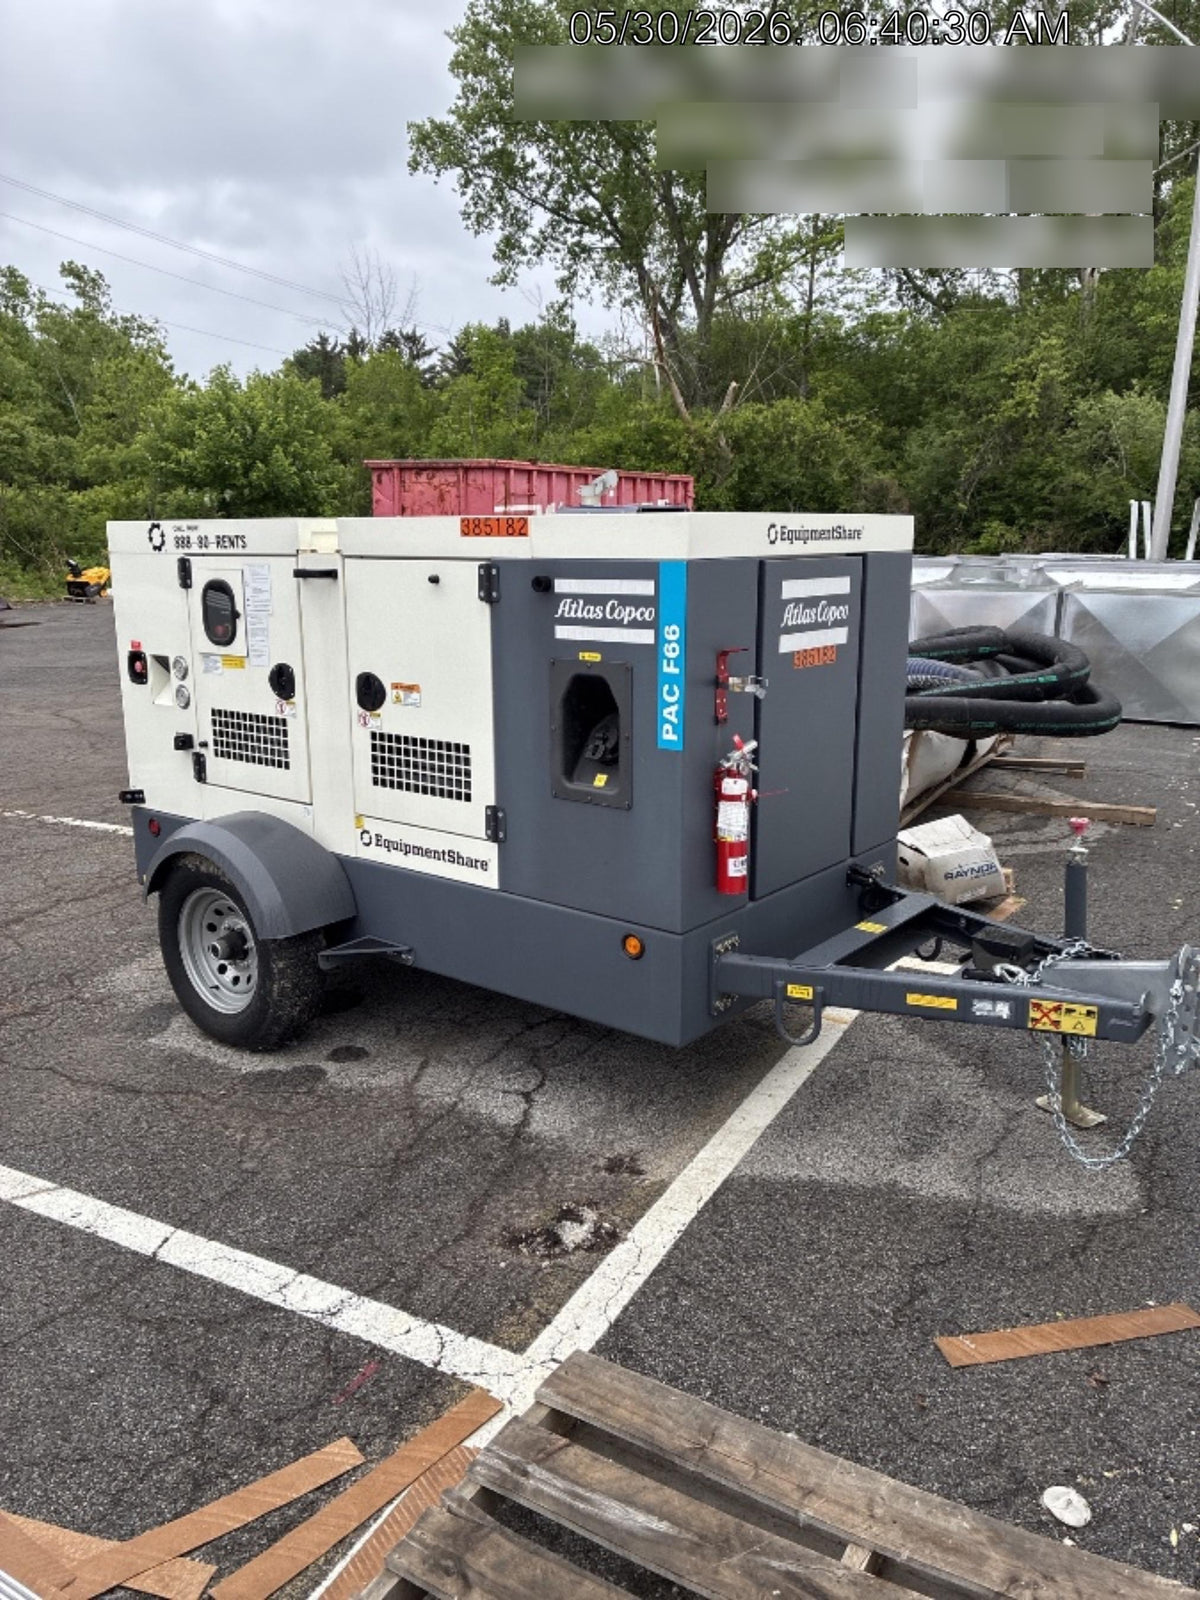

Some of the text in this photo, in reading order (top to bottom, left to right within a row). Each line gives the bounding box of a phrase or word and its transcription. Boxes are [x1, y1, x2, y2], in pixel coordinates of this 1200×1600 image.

[461, 518, 527, 536] 385182
[780, 525, 862, 544] EquipmentShare
[555, 598, 655, 624] Atlas Copco
[781, 601, 849, 628] Atlas Copco
[662, 624, 681, 741] PAC F66
[374, 833, 488, 872] EquipmentShare
